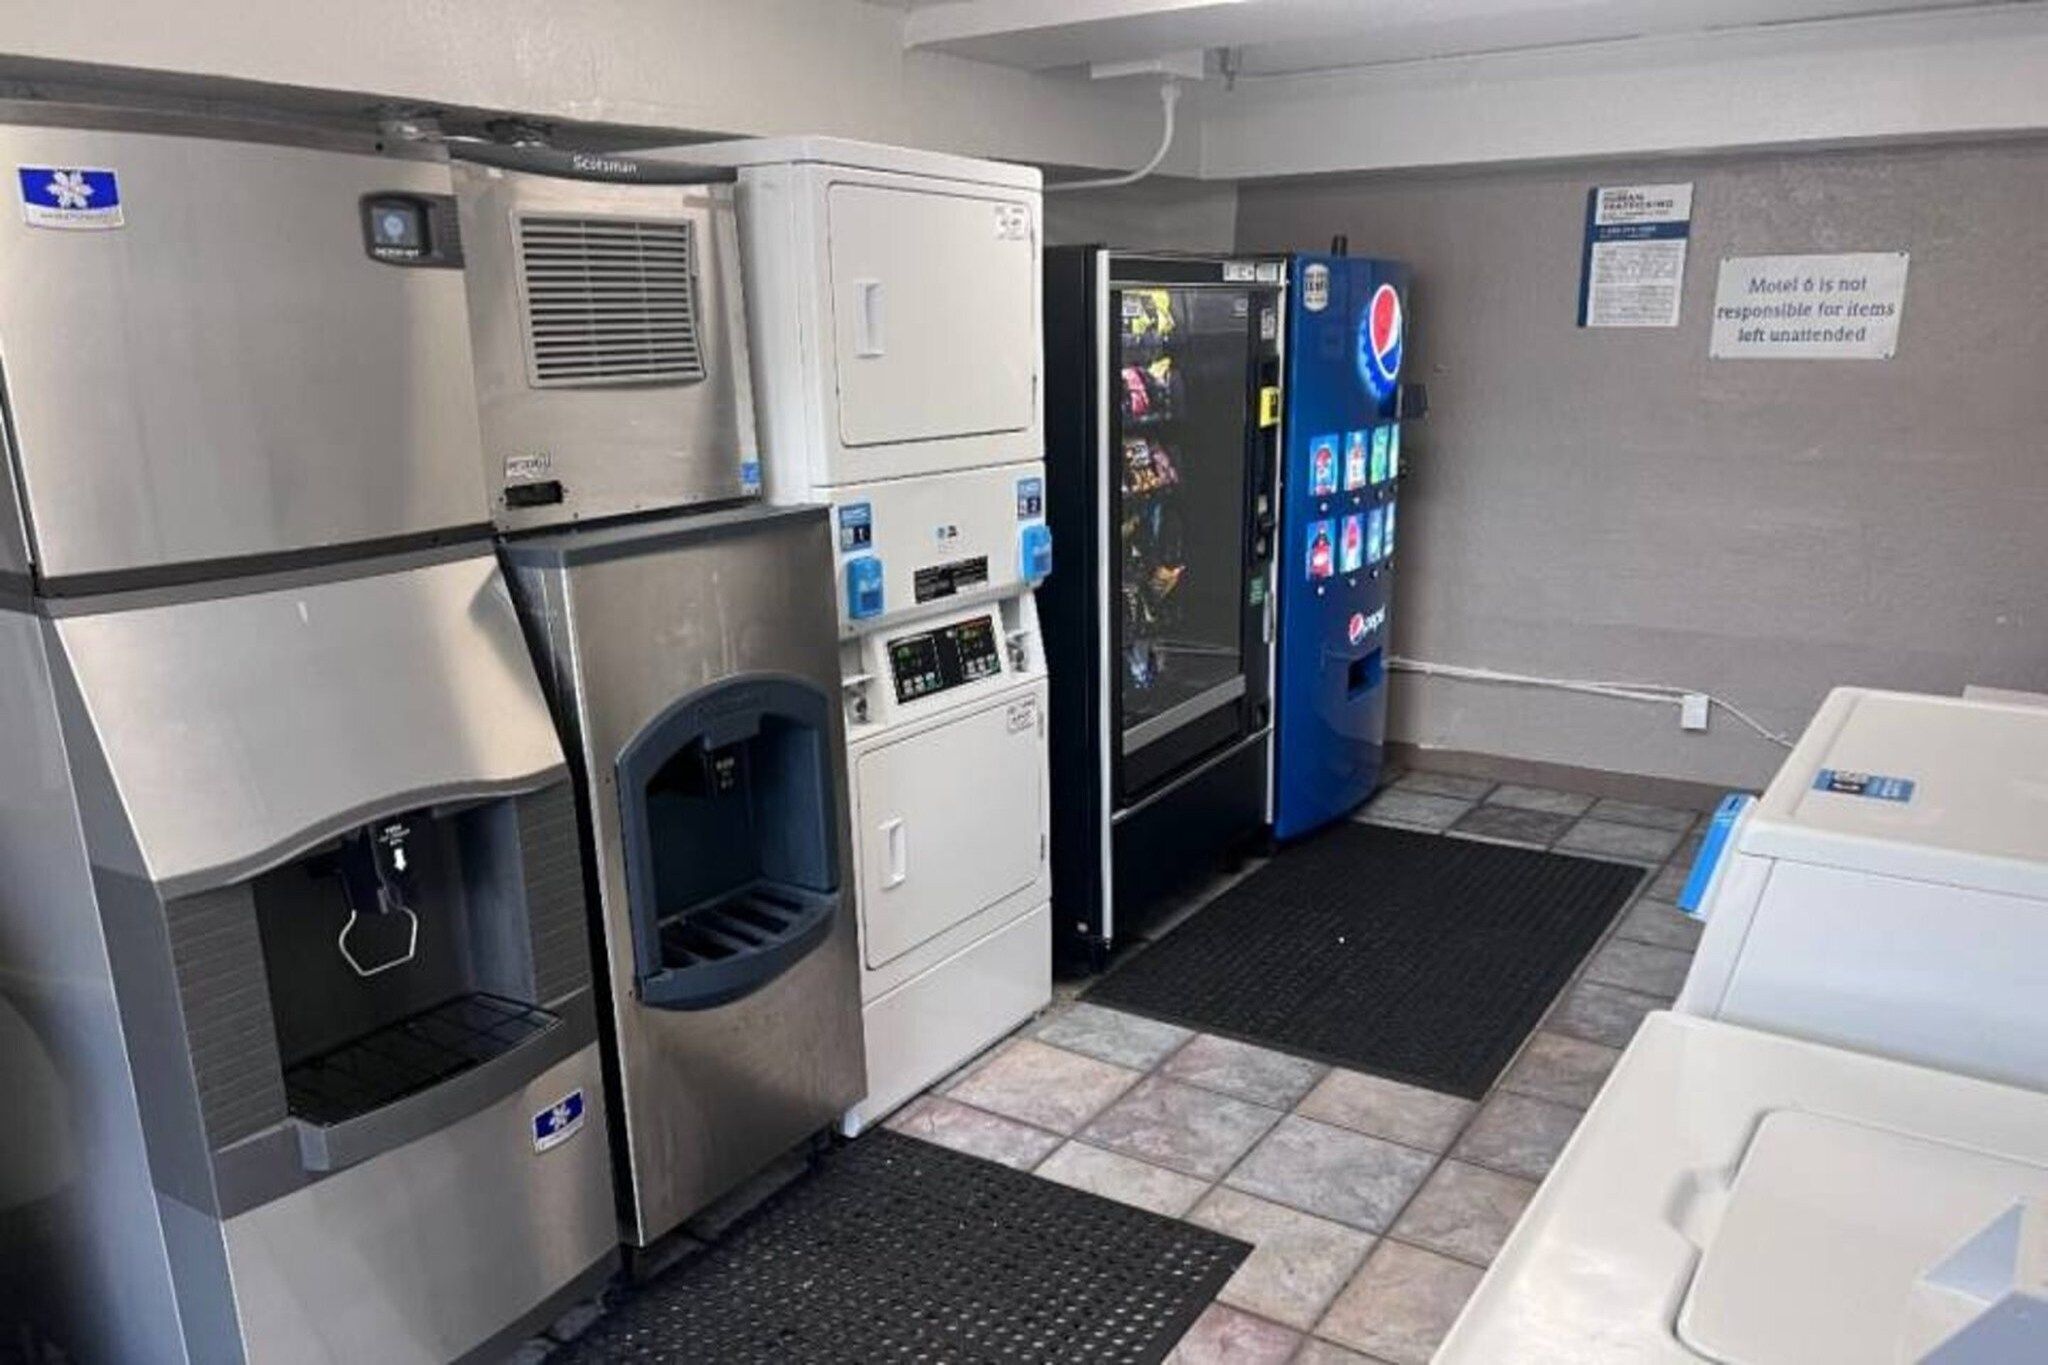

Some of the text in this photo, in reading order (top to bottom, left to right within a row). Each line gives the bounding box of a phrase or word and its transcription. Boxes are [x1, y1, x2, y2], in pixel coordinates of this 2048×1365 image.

[572, 153, 638, 174] Scotsman
[1749, 276, 1868, 294] Motel 6 is not
[1716, 301, 1896, 322] responsible for items
[1737, 326, 1867, 343] left unattended
